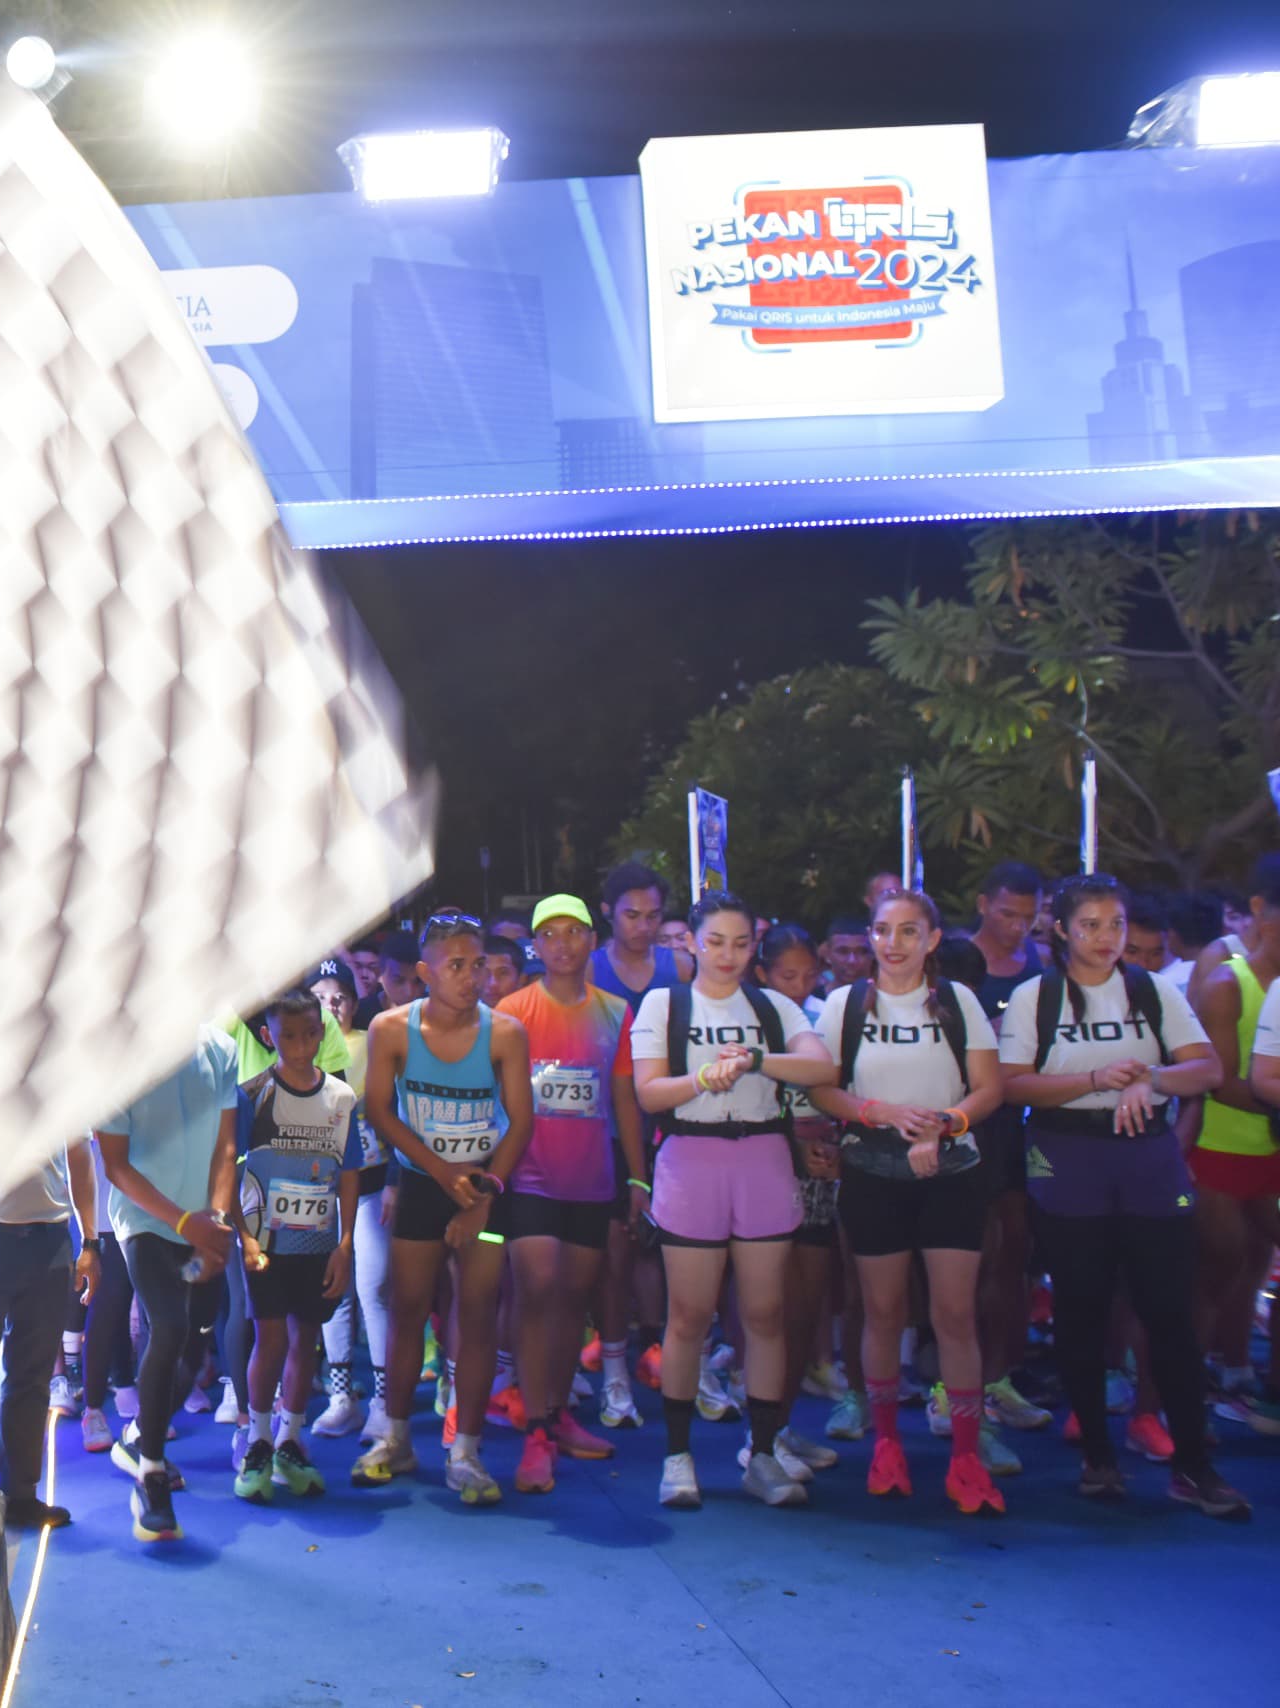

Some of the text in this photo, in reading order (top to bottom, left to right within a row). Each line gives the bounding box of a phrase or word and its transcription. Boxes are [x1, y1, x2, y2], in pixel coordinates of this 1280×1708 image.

[689, 198, 958, 249] PEKAN QRIS
[671, 249, 982, 295] NASIONAL 2024
[722, 302, 936, 324] Pakai QRIS untuk Indonesia Maju
[862, 1023, 942, 1044] RIOT
[1055, 1019, 1146, 1043] RIOT
[541, 1083, 593, 1101] 0733
[433, 1136, 492, 1153] 0776
[276, 1197, 329, 1215] 0176
